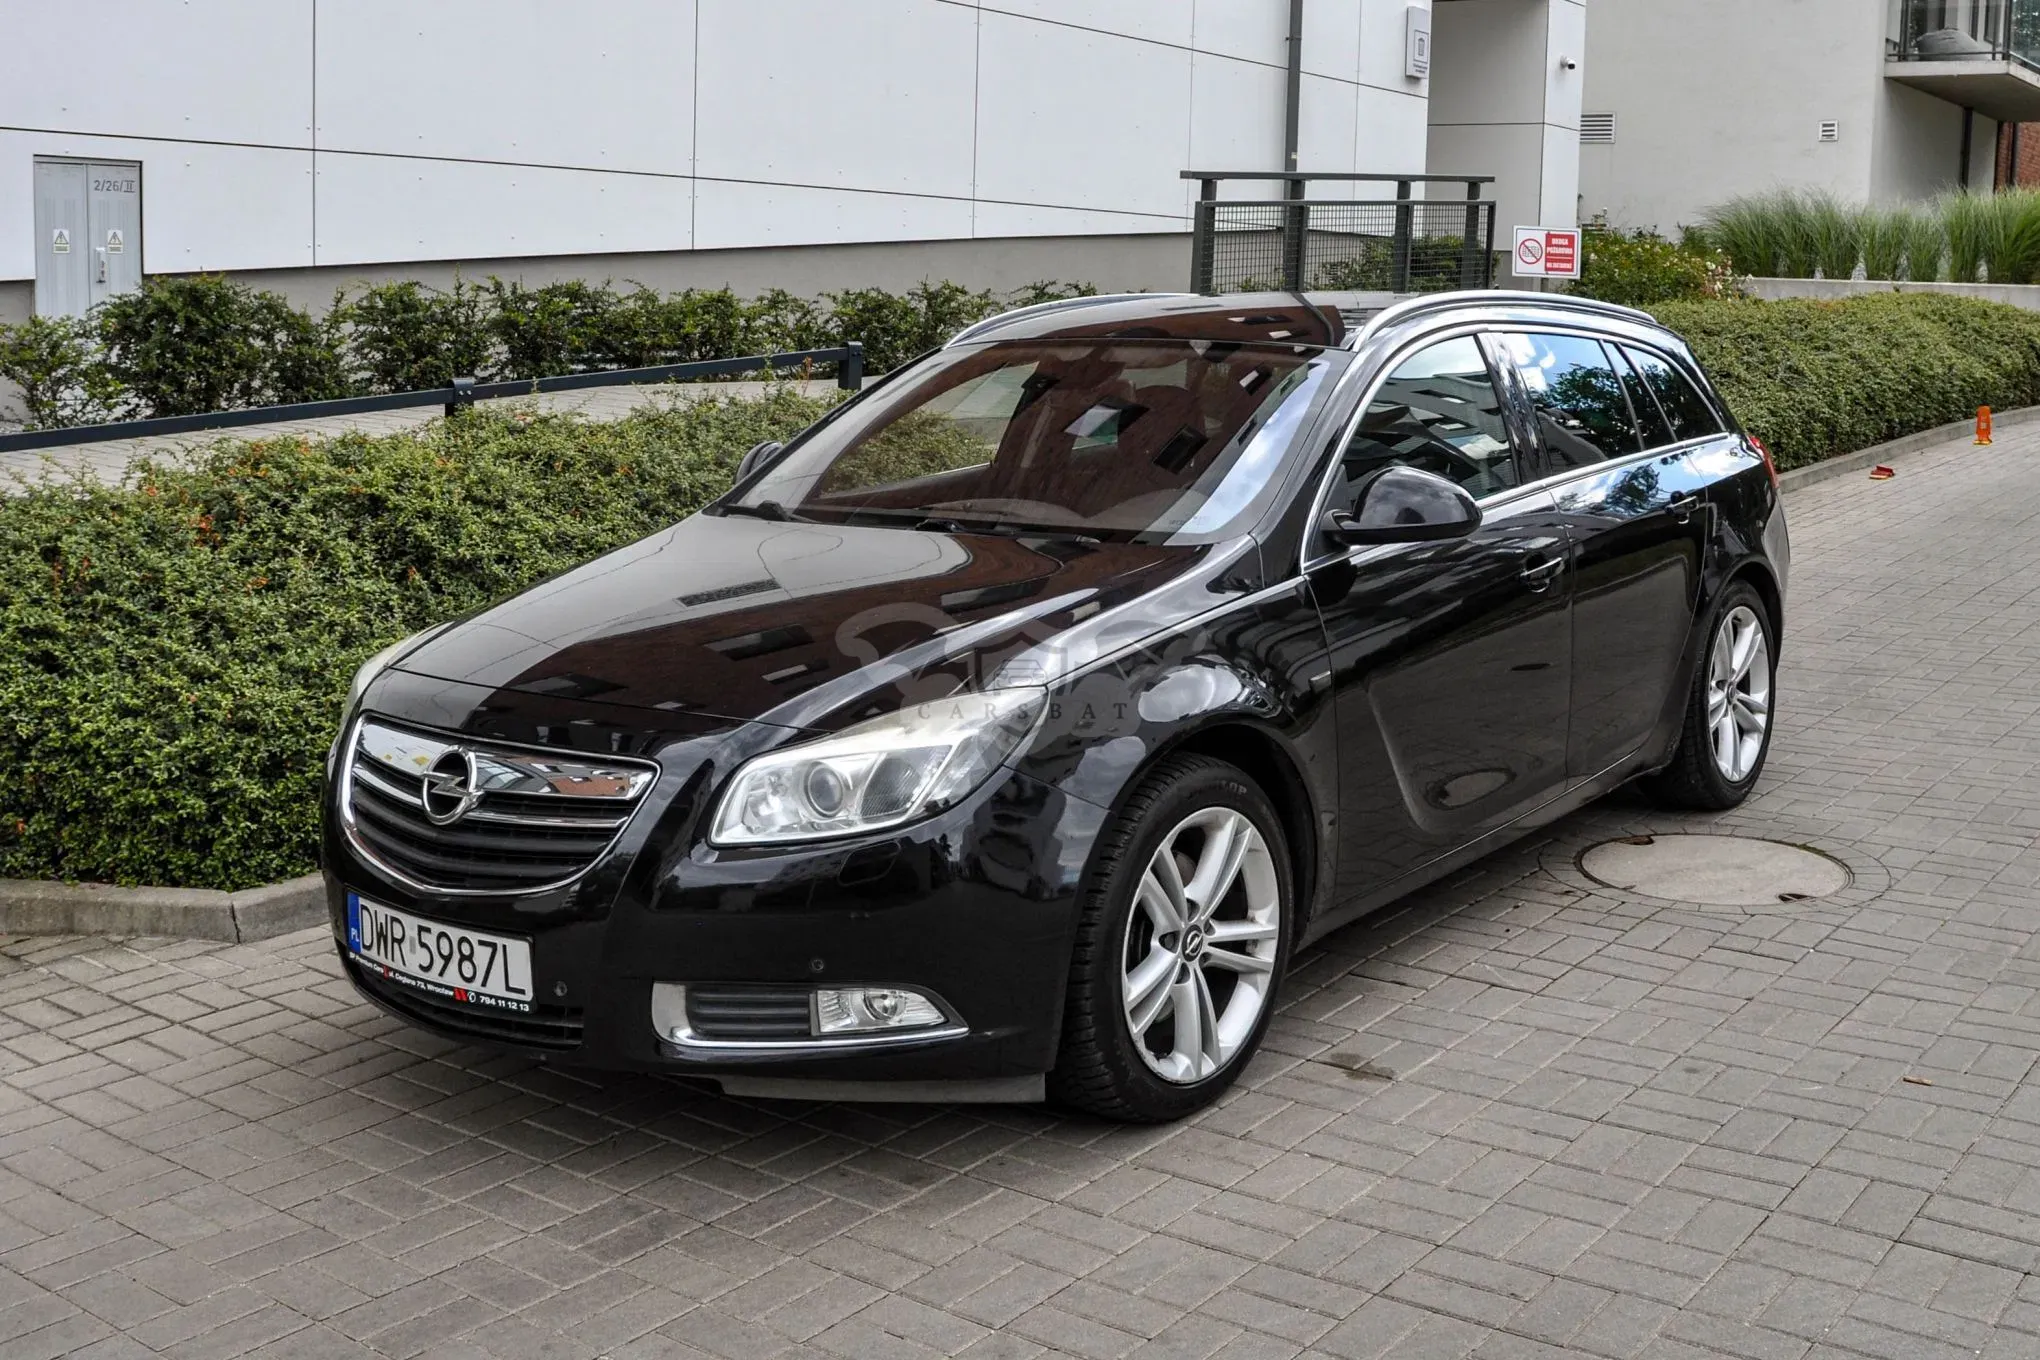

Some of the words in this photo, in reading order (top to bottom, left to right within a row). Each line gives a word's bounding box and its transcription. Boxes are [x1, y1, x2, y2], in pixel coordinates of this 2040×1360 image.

[93, 179, 136, 193] 2/26/II
[351, 927, 359, 942] PL
[360, 904, 406, 966] DWR
[417, 924, 526, 995] 5987L
[497, 1000, 506, 1008] 11
[507, 1001, 518, 1010] 12
[519, 1003, 529, 1012] 13
